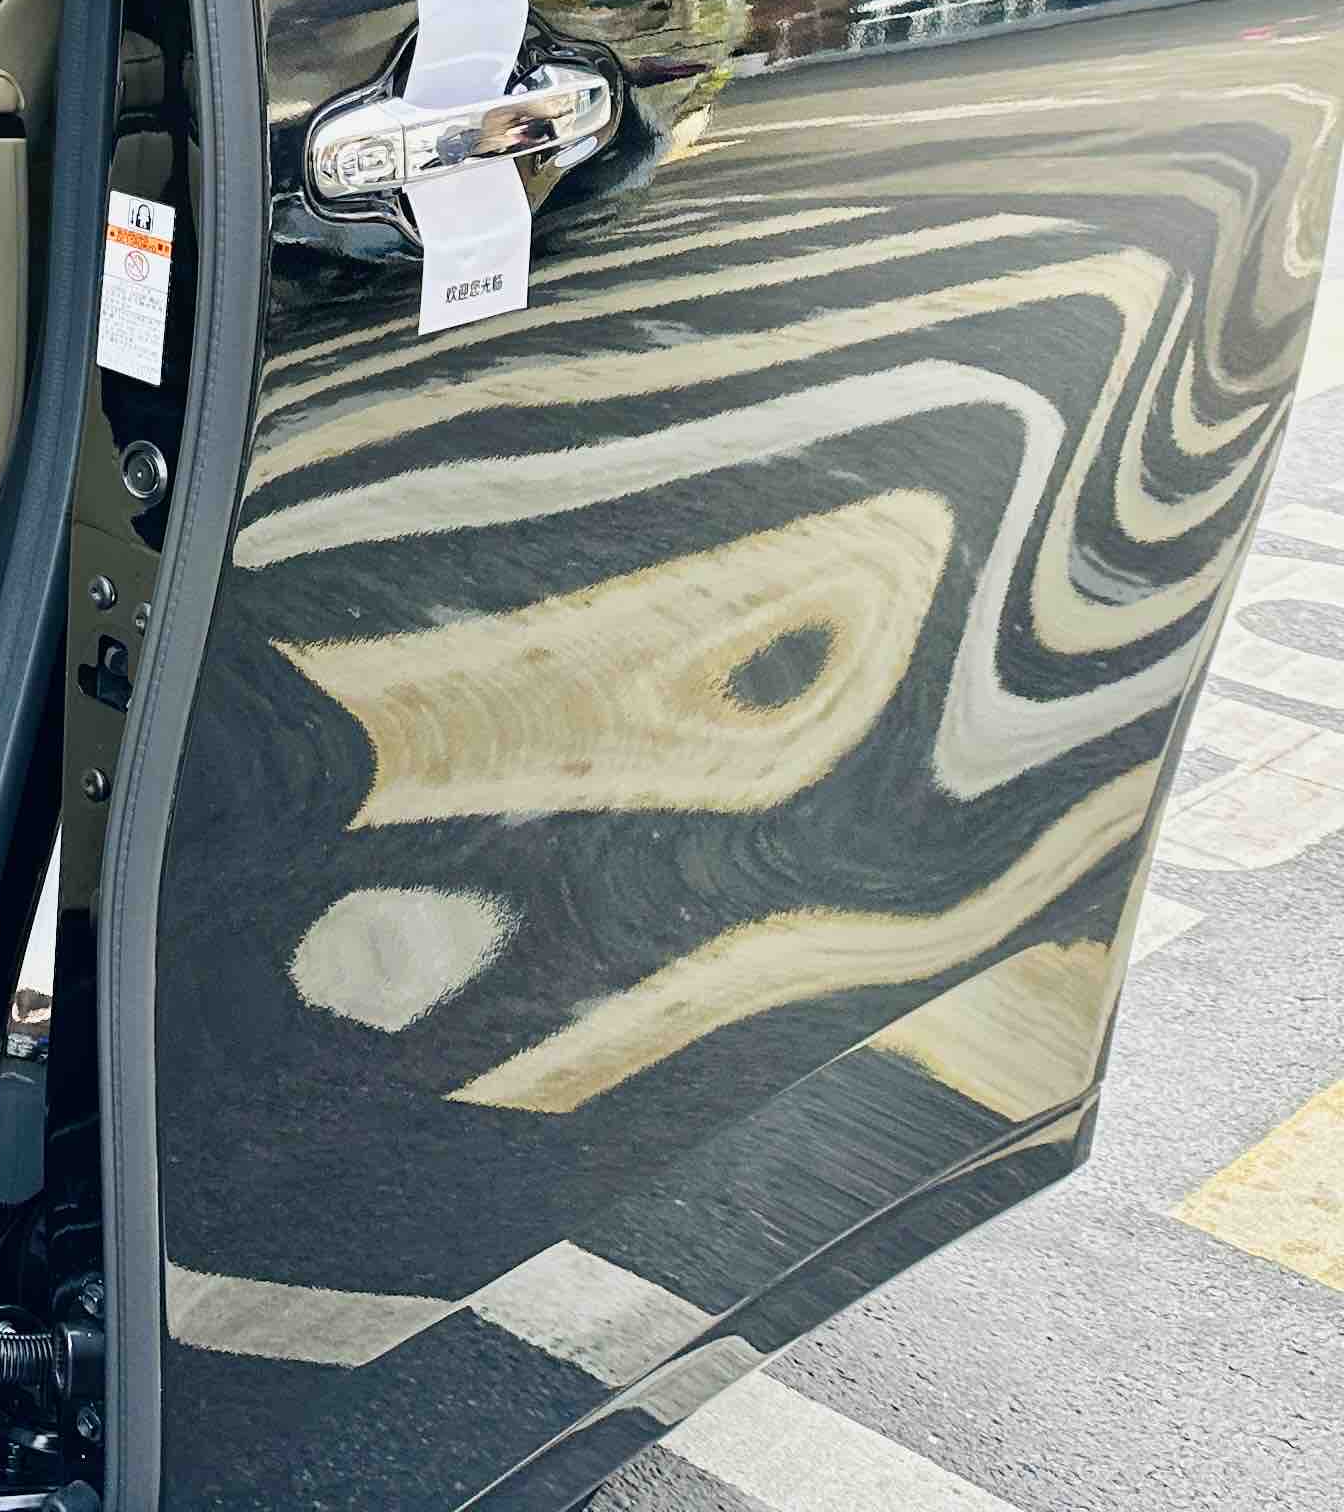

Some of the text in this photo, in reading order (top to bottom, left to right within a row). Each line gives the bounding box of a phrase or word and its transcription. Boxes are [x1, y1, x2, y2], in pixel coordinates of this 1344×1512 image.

[446, 273, 503, 304] 欢迎您光临
